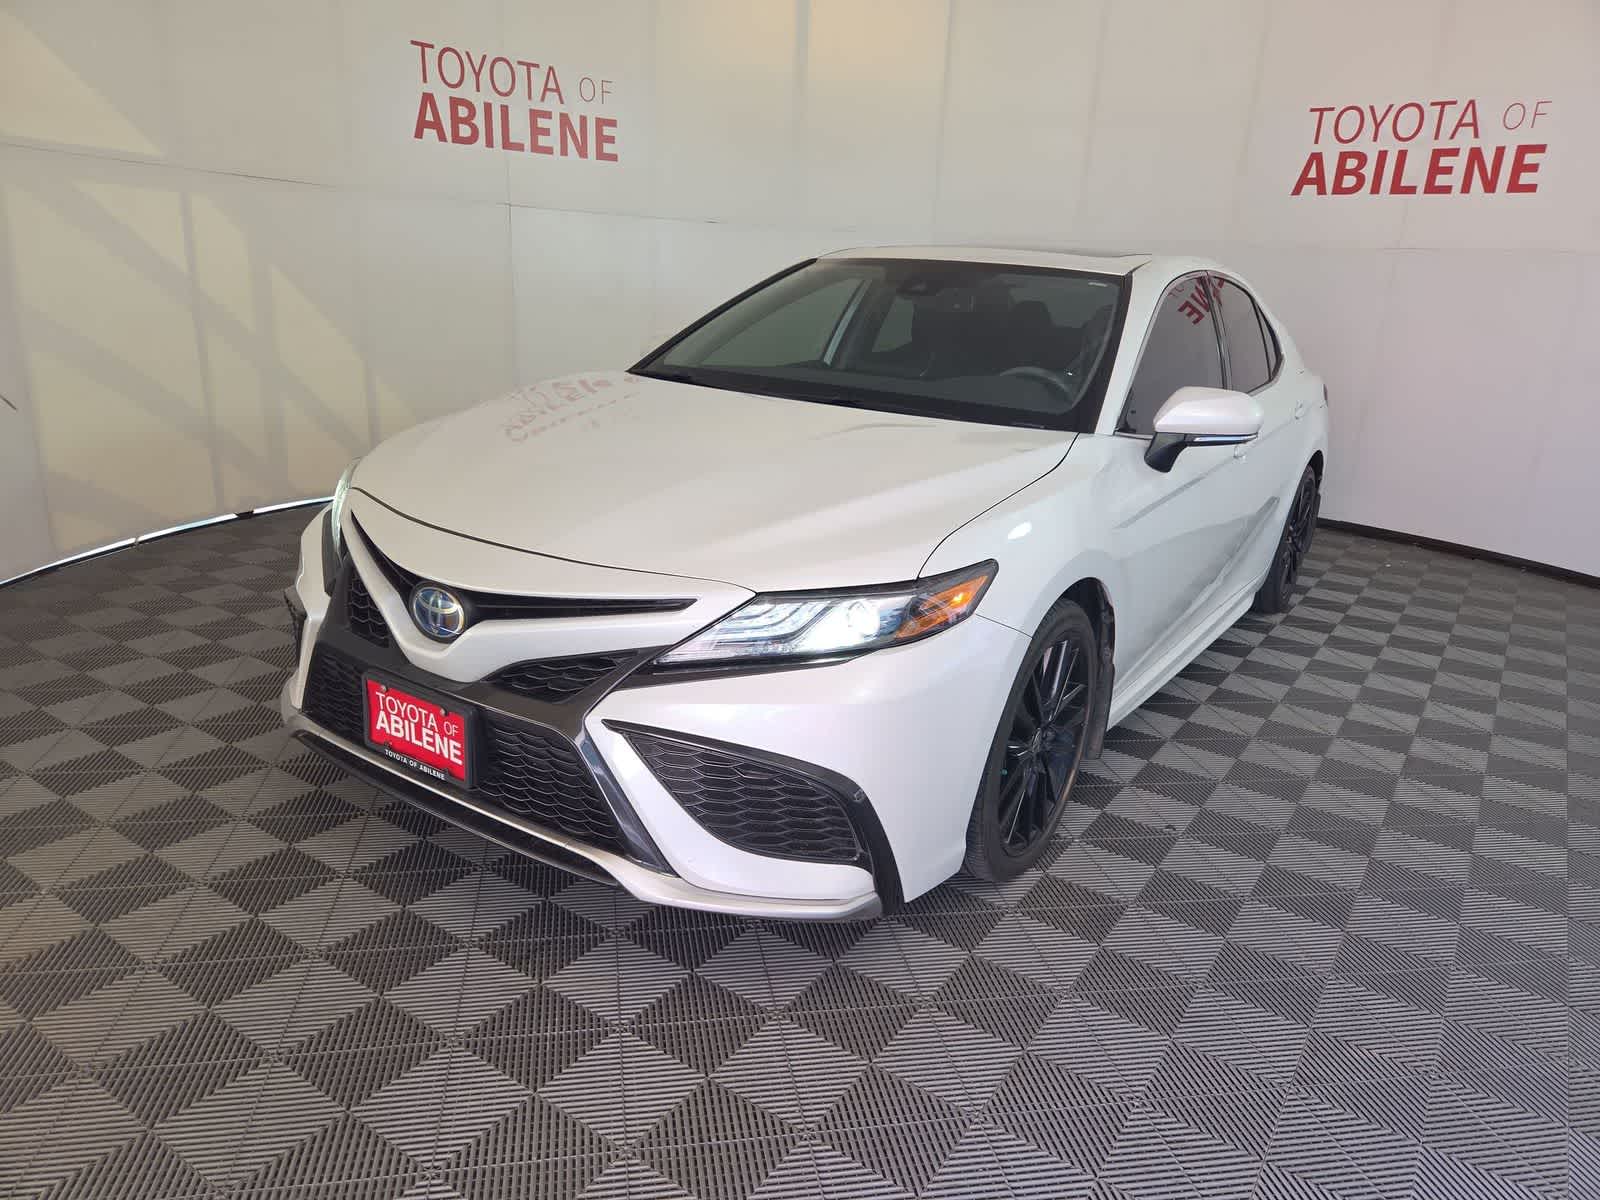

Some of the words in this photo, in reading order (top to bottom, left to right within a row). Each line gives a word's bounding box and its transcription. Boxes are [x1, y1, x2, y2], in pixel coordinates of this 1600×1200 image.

[410, 39, 564, 104] TOYOTA
[579, 77, 613, 104] OF
[414, 92, 618, 162] ABILENE
[1309, 99, 1480, 144] TOYOTA
[1503, 100, 1552, 130] OF
[1290, 144, 1547, 196] ABILENE
[375, 691, 438, 732] TOYOTA
[443, 721, 458, 736] OF
[376, 710, 463, 765] ABILENE
[385, 749, 408, 764] TOYOTA
[409, 760, 417, 768] OF
[419, 764, 445, 780] ABILENE
